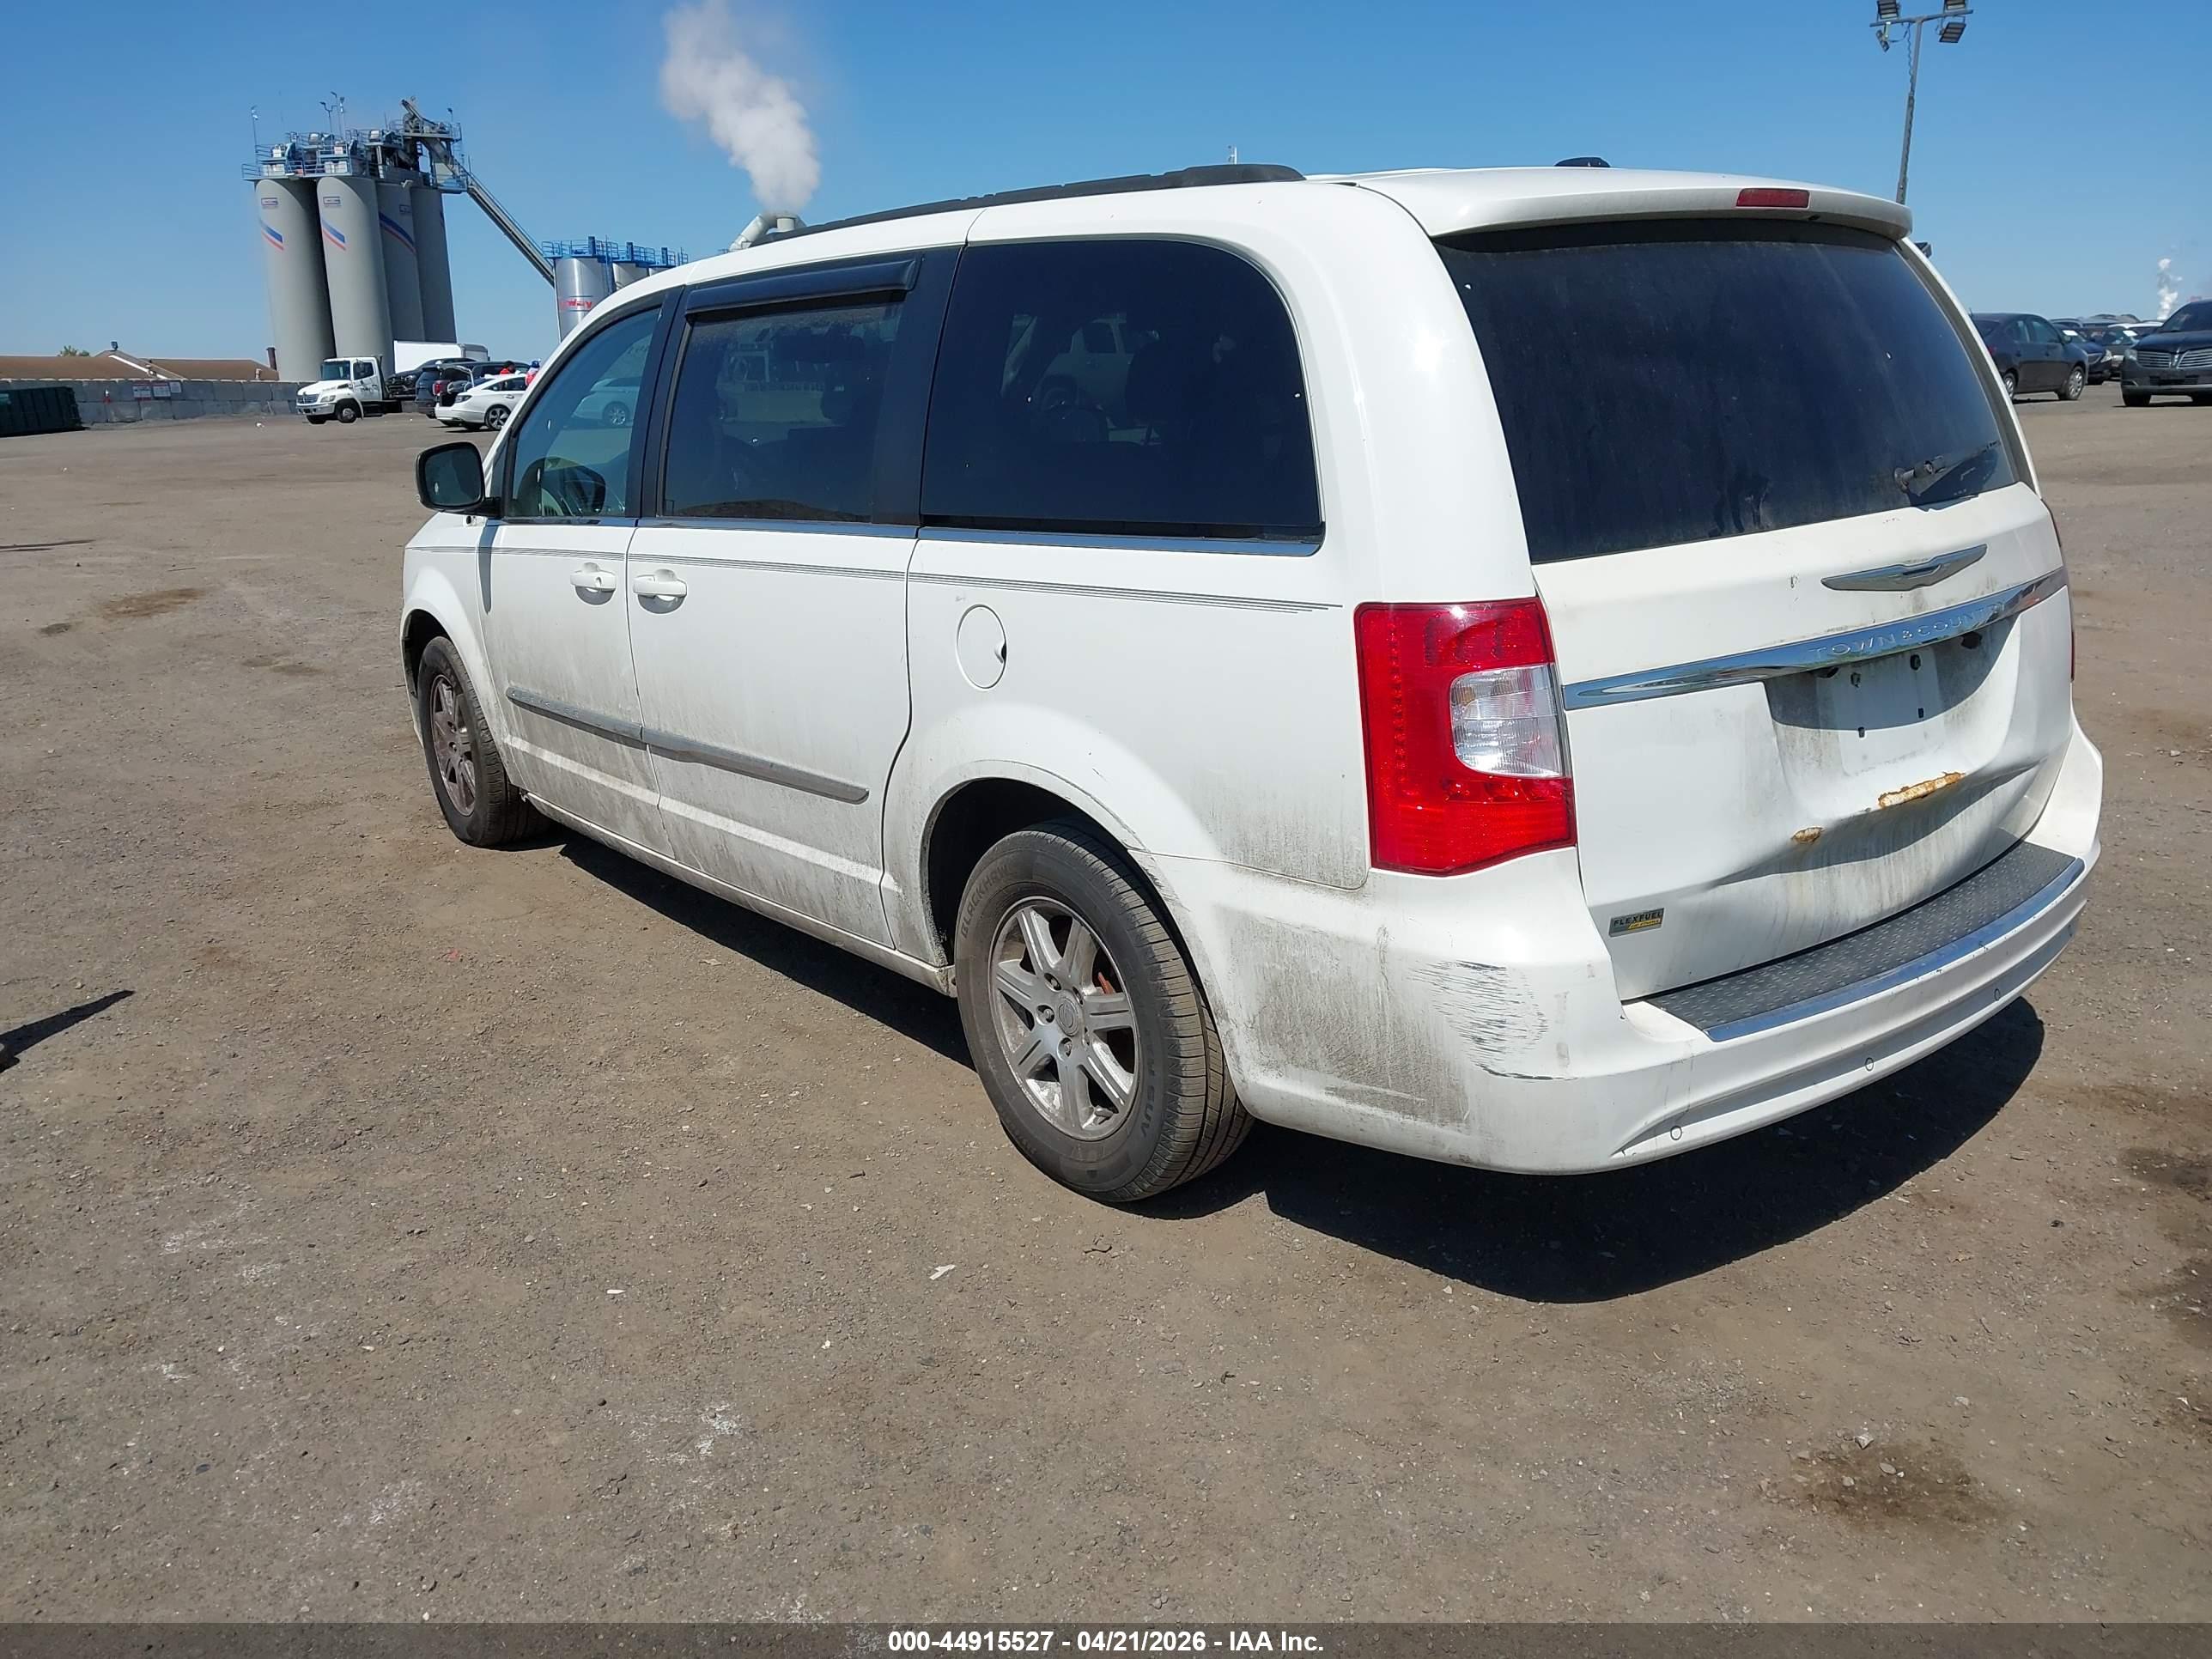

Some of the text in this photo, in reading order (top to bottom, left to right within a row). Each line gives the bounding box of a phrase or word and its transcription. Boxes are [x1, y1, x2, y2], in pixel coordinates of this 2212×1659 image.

[1808, 632, 1896, 659] TOWN
[1917, 601, 2006, 637] COUNTRY
[1613, 911, 1661, 926] FLEXFUEL
